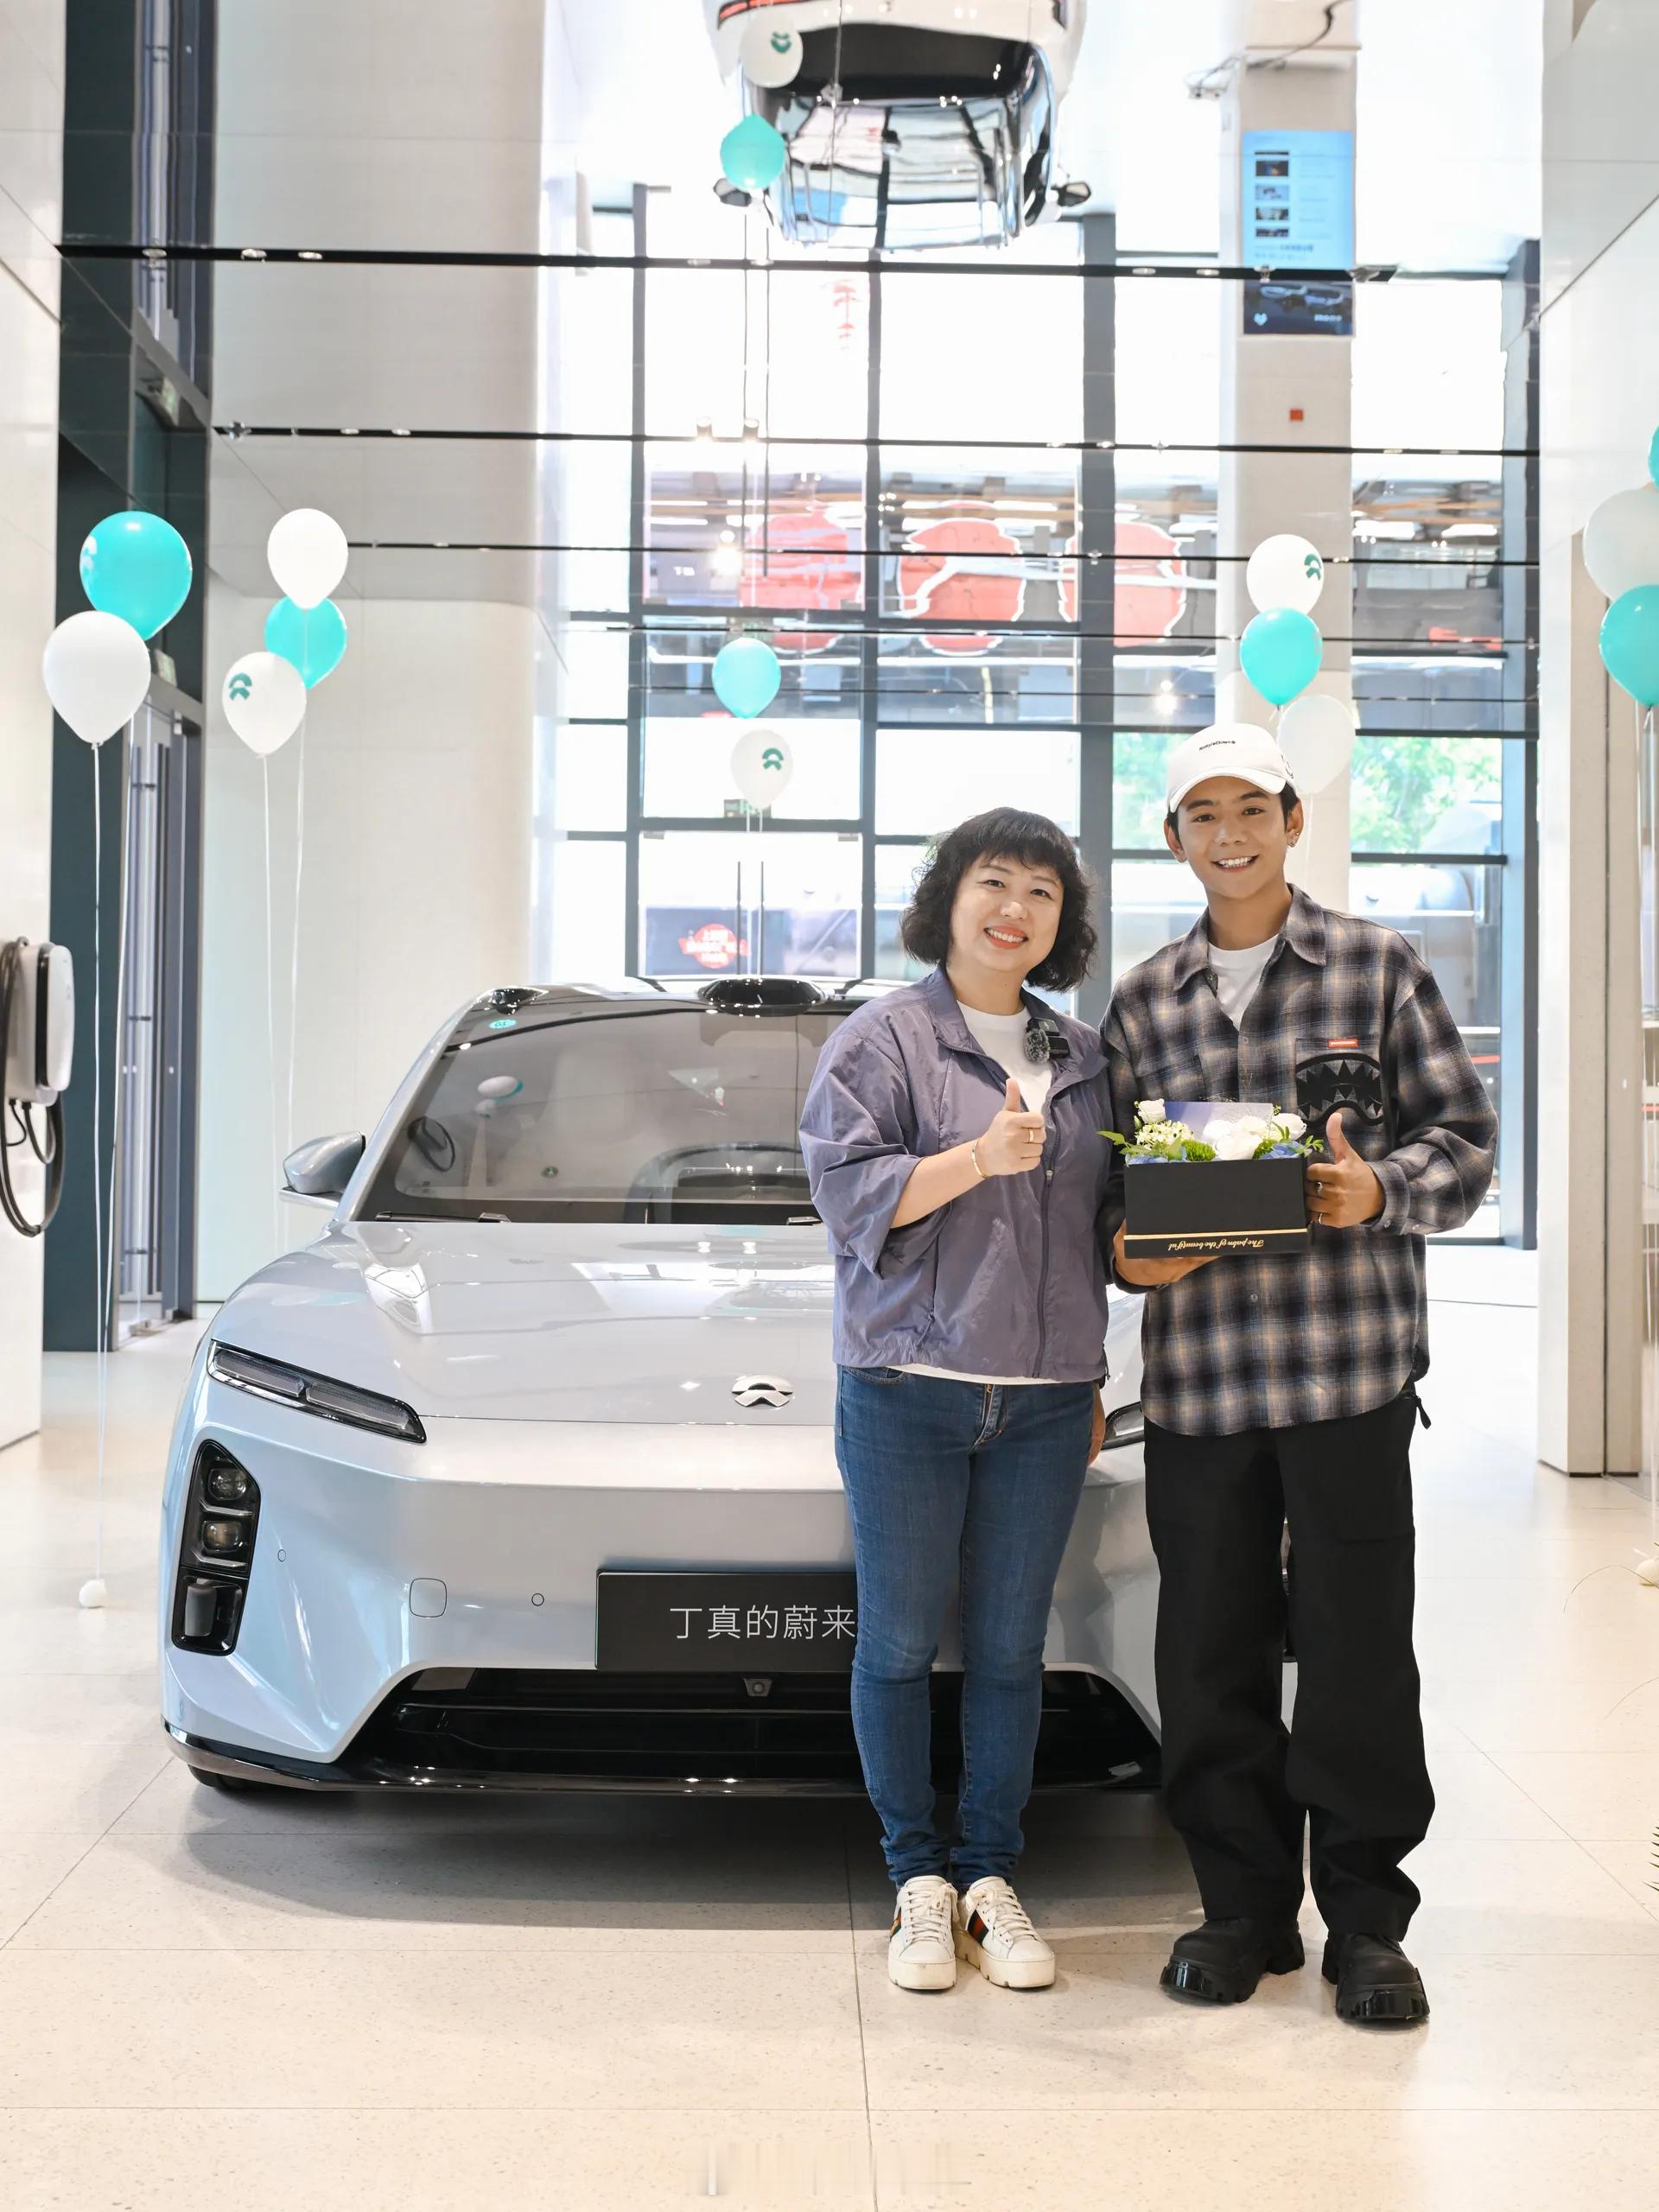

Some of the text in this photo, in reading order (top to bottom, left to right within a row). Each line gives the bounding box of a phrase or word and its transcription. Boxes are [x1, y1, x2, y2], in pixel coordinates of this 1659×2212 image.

[1168, 1241, 1204, 1250] beautiful
[1216, 1239, 1227, 1249] of
[1227, 1238, 1249, 1248] palm
[1246, 1239, 1264, 1248] The
[670, 1604, 856, 1640] 丁真的蔚来
